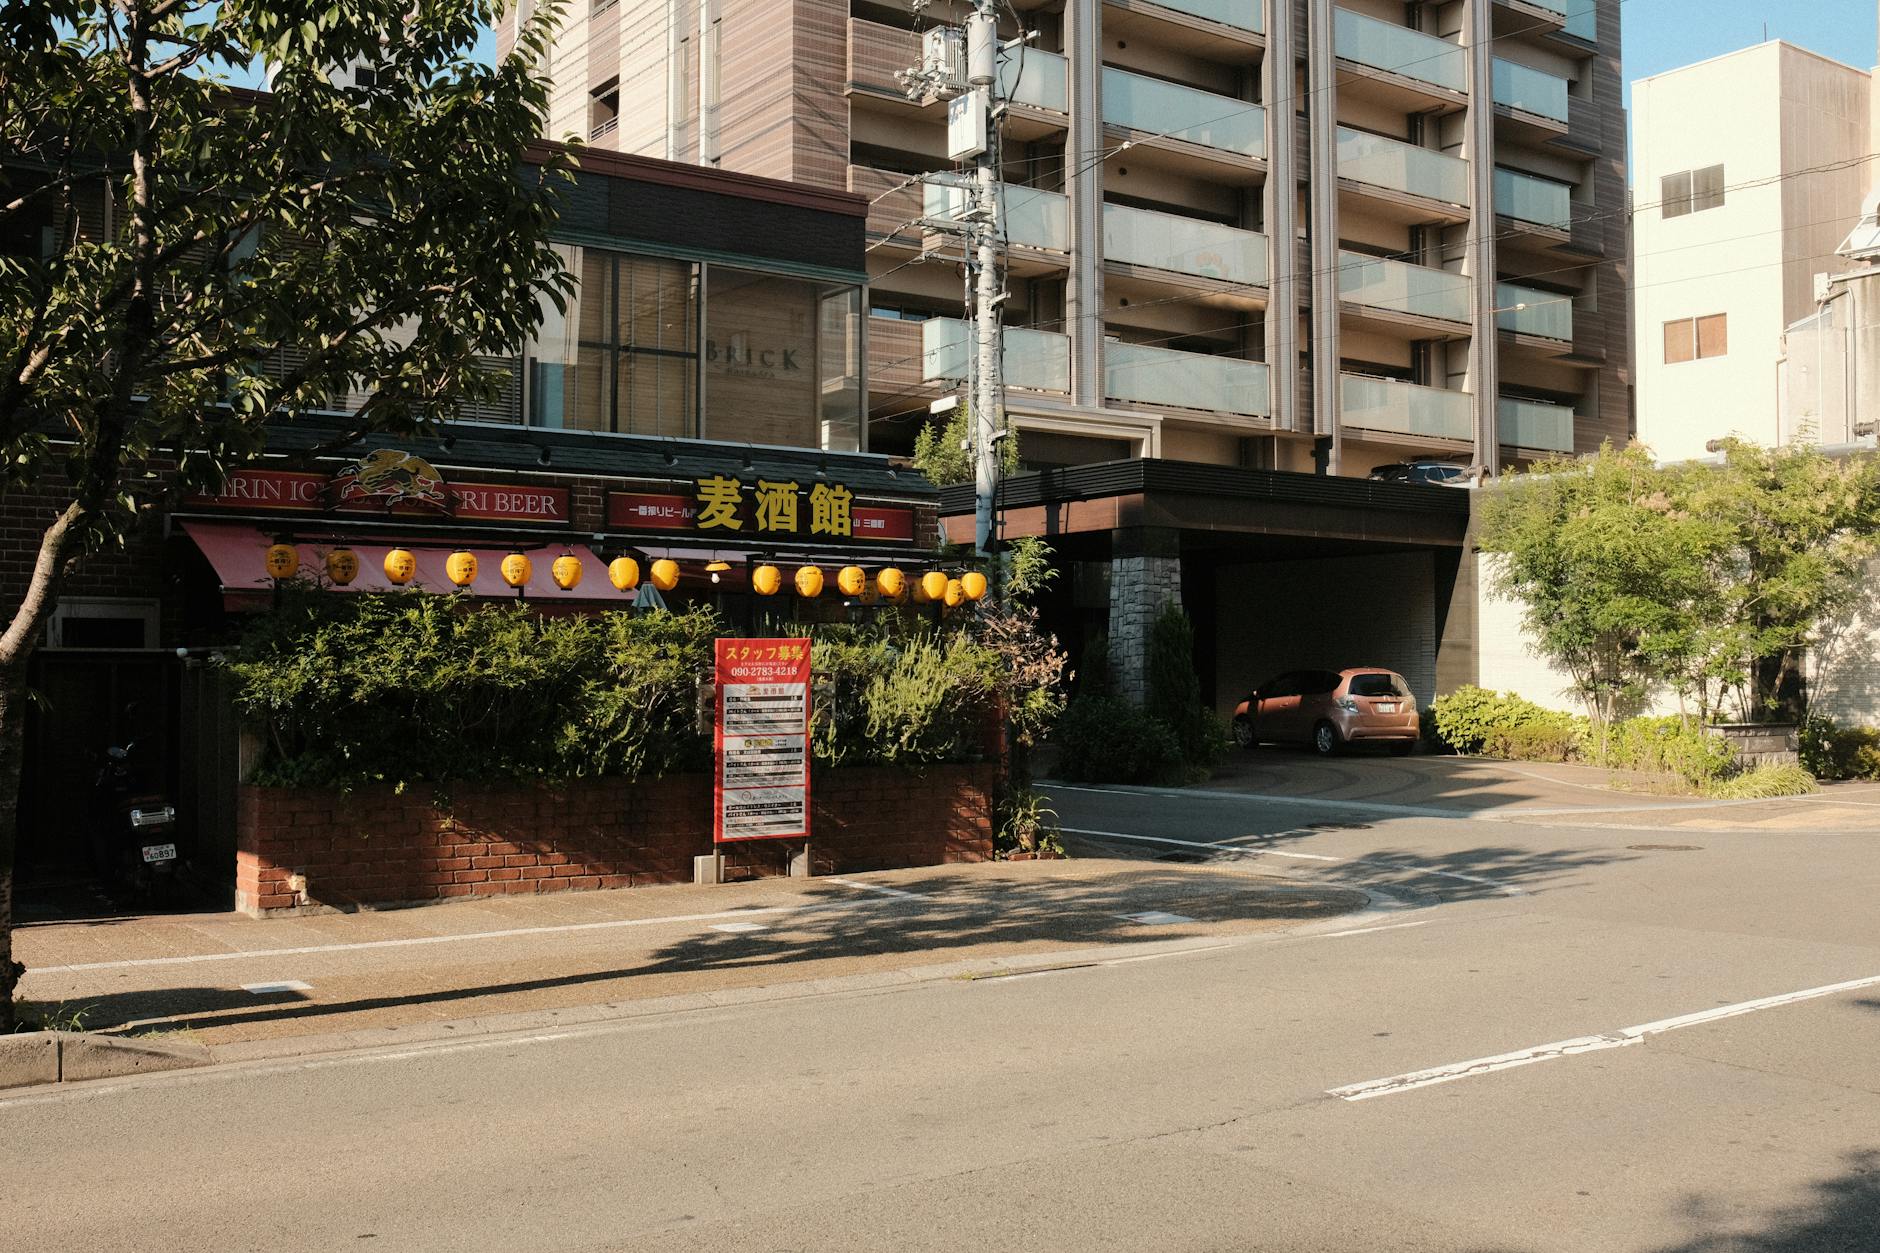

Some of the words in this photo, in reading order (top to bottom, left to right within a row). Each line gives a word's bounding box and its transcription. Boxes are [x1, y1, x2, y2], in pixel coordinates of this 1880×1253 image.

[706, 339, 801, 370] BRICK
[494, 492, 559, 515] BEER
[696, 474, 854, 537] 麦酒館
[725, 645, 804, 661] スタッフ募集
[731, 666, 798, 677] 090-2783-4218
